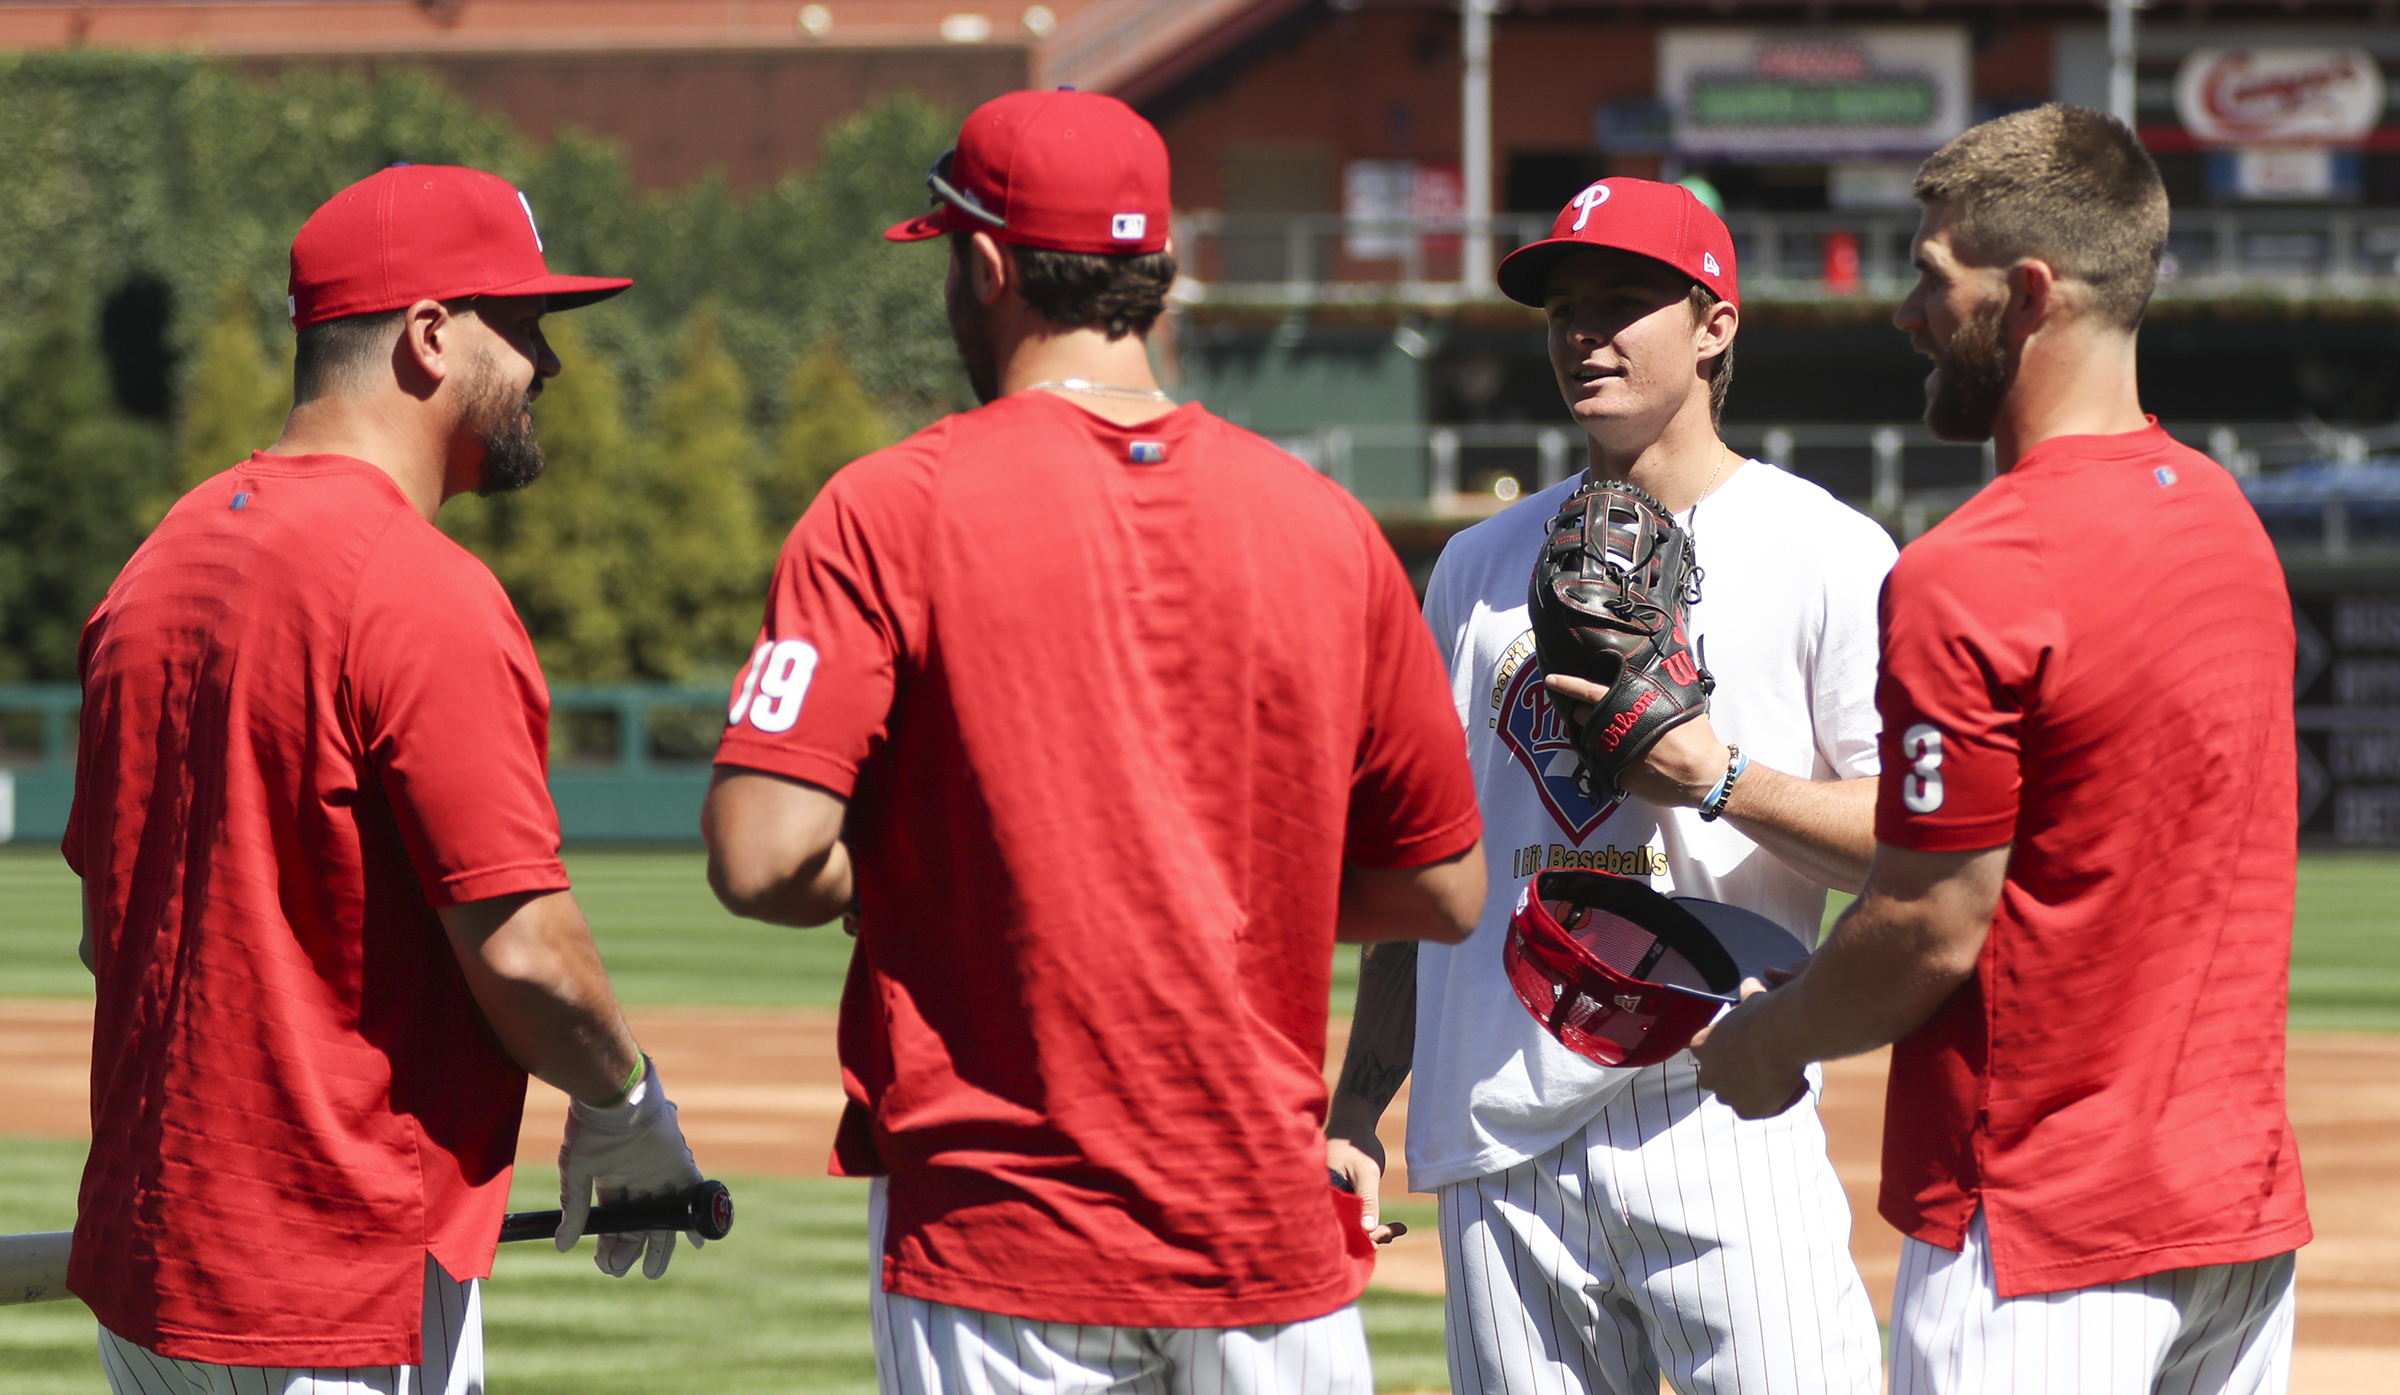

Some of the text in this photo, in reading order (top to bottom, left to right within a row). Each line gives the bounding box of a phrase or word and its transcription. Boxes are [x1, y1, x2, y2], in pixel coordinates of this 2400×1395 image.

[1573, 184, 1611, 232] P
[1491, 641, 1530, 710] Don't
[1597, 690, 1657, 754] Wilson
[1903, 723, 1944, 814] 3
[1514, 844, 1668, 879] I Hit Baseballs
